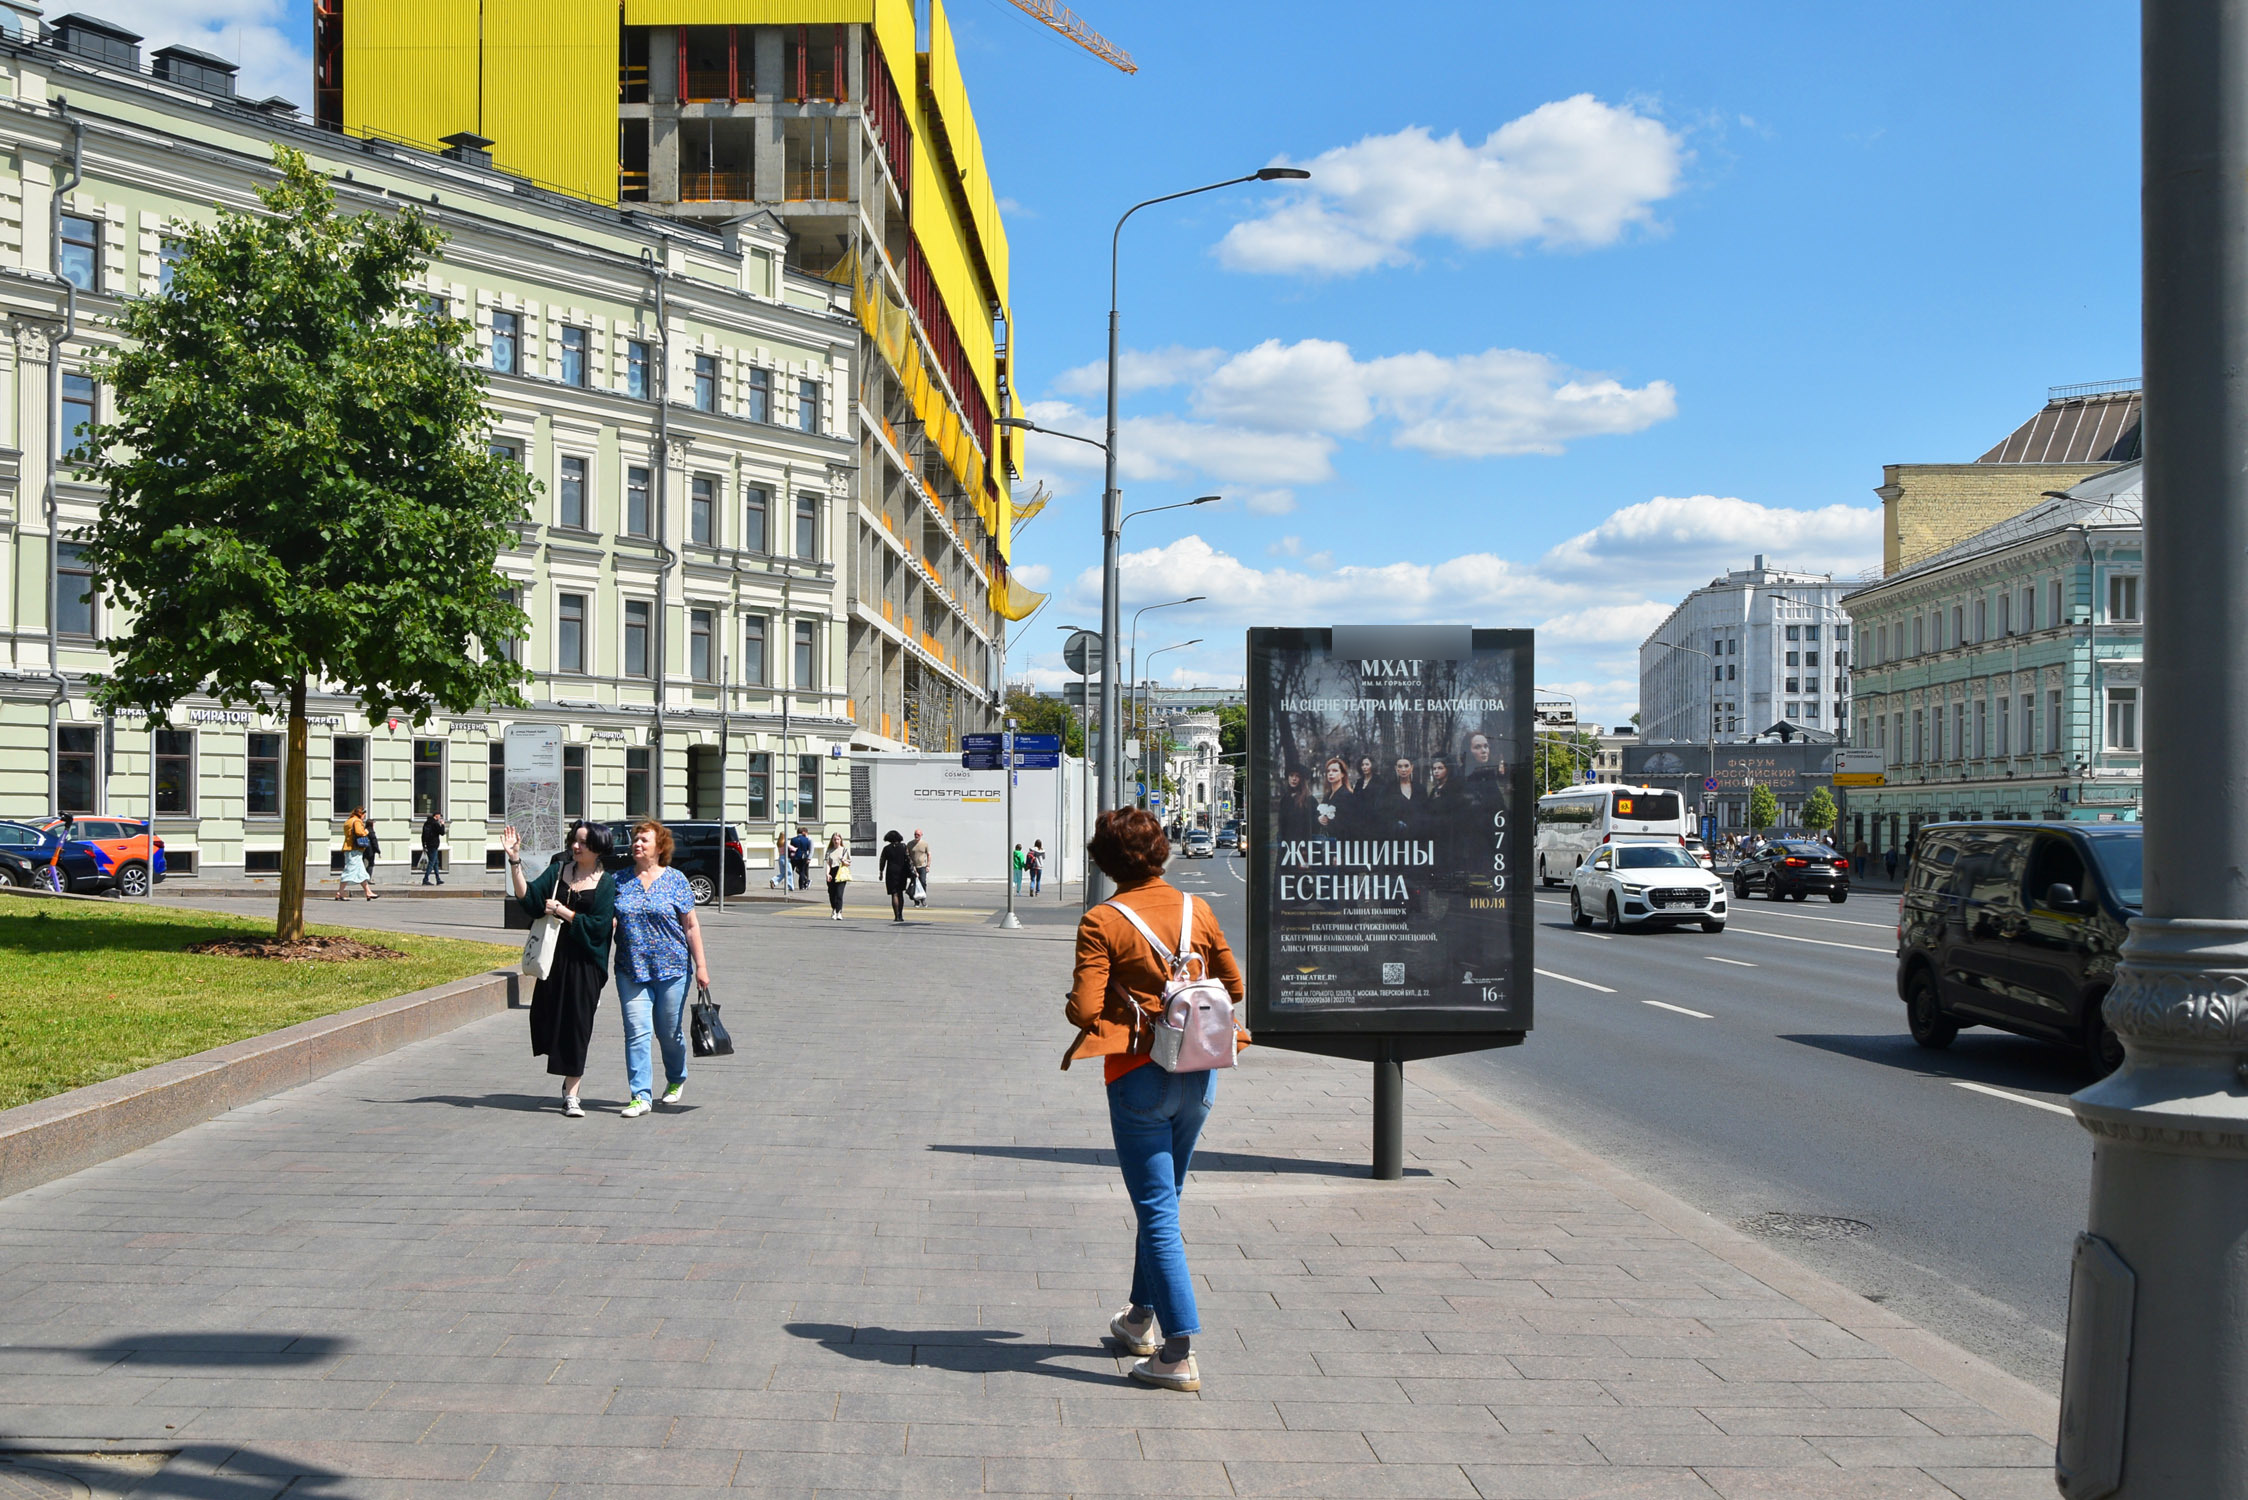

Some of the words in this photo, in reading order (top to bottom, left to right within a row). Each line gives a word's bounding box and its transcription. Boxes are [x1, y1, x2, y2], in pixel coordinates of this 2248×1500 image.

[1361, 659, 1423, 677] МХАТ
[1280, 699, 1297, 712] НА
[1300, 699, 1340, 713] СЦЕНЕ
[1343, 699, 1386, 712] ТЕАТРА
[1389, 699, 1411, 712] ИМ.
[1414, 699, 1425, 712] Е.
[1427, 699, 1505, 712] ВАХТАНГОВА
[190, 709, 253, 722] МИРАТОРГ
[1728, 759, 1775, 767] ФОРУМ
[914, 789, 1001, 797] CONSTRUCTOR
[1493, 810, 1506, 828] 6
[1494, 832, 1505, 849] 7
[1281, 840, 1434, 871] ЖЕНЩИНЫ
[1493, 853, 1506, 871] 8
[1281, 874, 1409, 901] ЕСЕНИНА
[1493, 875, 1505, 893] 9
[1470, 897, 1506, 909] ИЮЛЯ
[1312, 923, 1353, 931] ЕКАТЕРИНЫ
[1281, 934, 1323, 942] ЕКАТЕРИНЫ
[1323, 933, 1364, 942] ВОЛКОВОЙ,
[1481, 986, 1507, 1002] 16+
